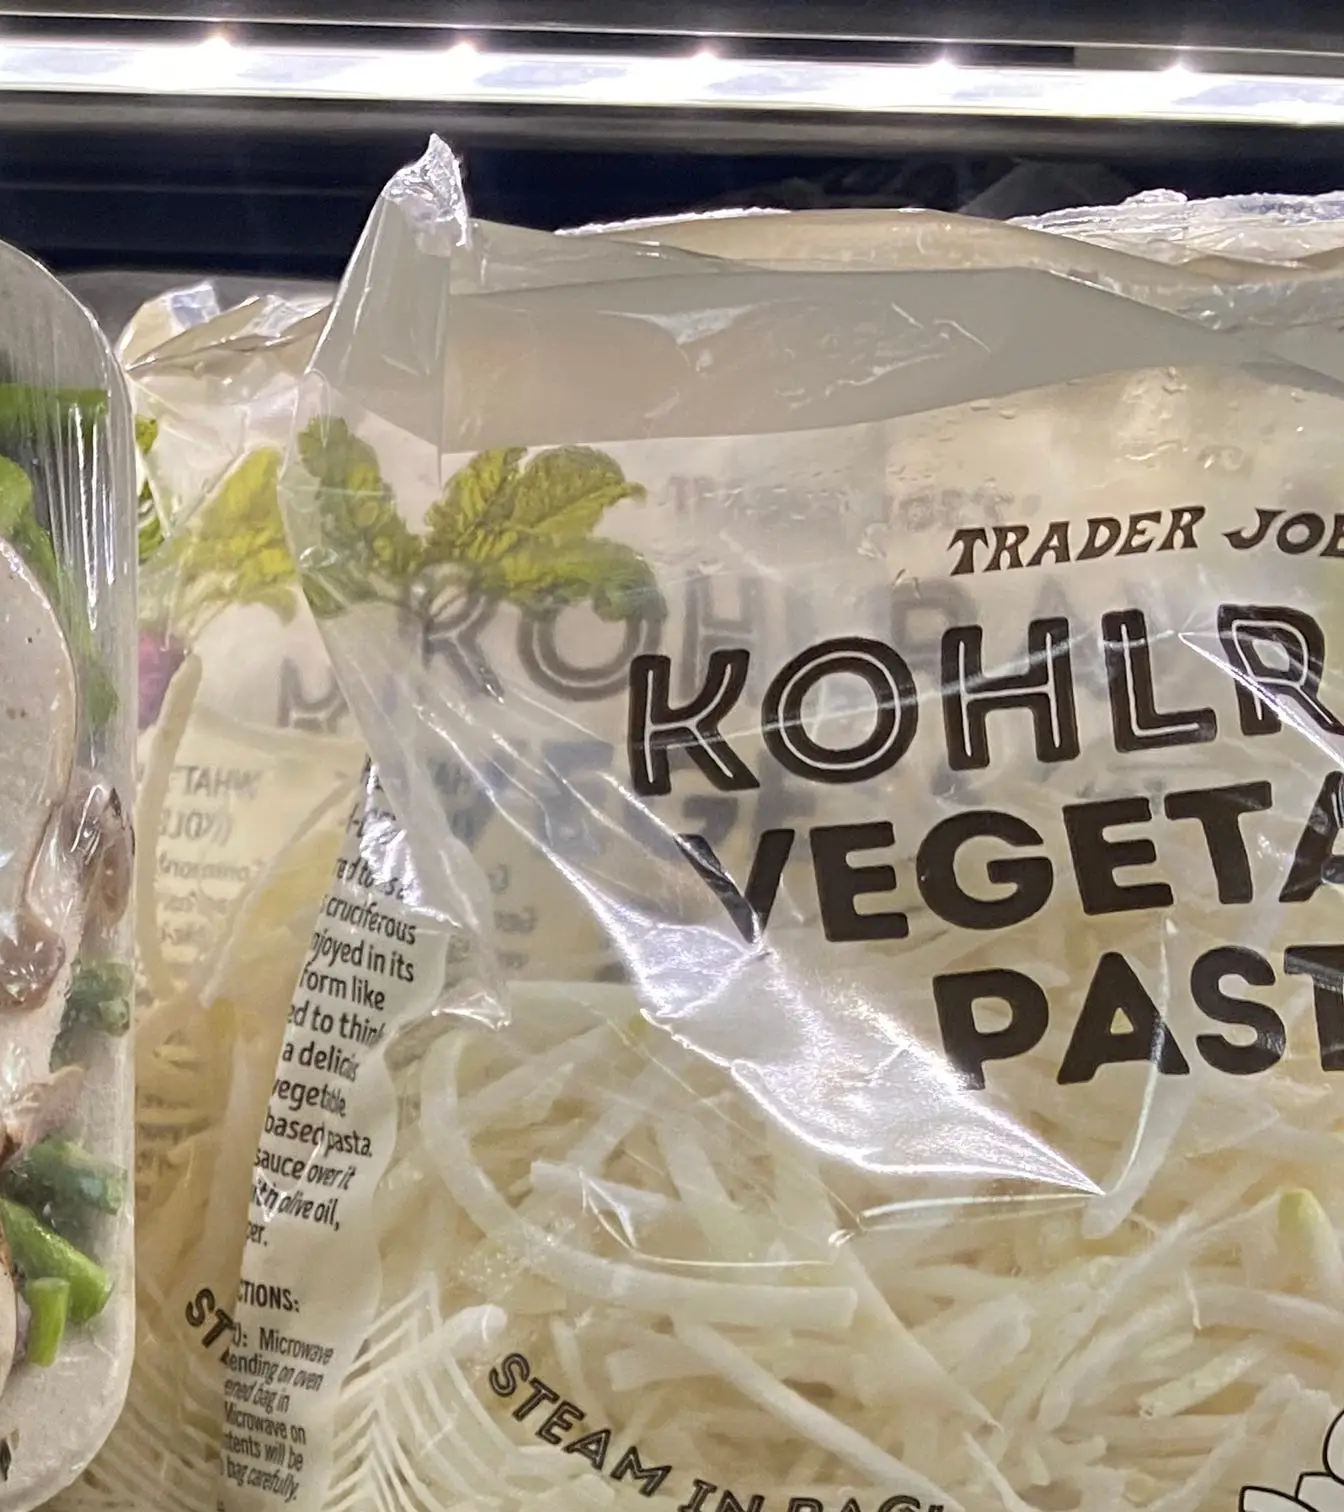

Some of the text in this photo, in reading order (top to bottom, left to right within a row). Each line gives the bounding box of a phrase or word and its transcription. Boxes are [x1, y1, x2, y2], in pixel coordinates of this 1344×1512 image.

[947, 506, 1207, 577] TRADER
[368, 945, 385, 974] in
[390, 951, 415, 982] its
[351, 975, 385, 1011] like
[312, 1005, 333, 1035] to
[282, 1042, 294, 1062] a
[290, 1424, 307, 1445] on
[488, 1352, 672, 1498] STEAM
